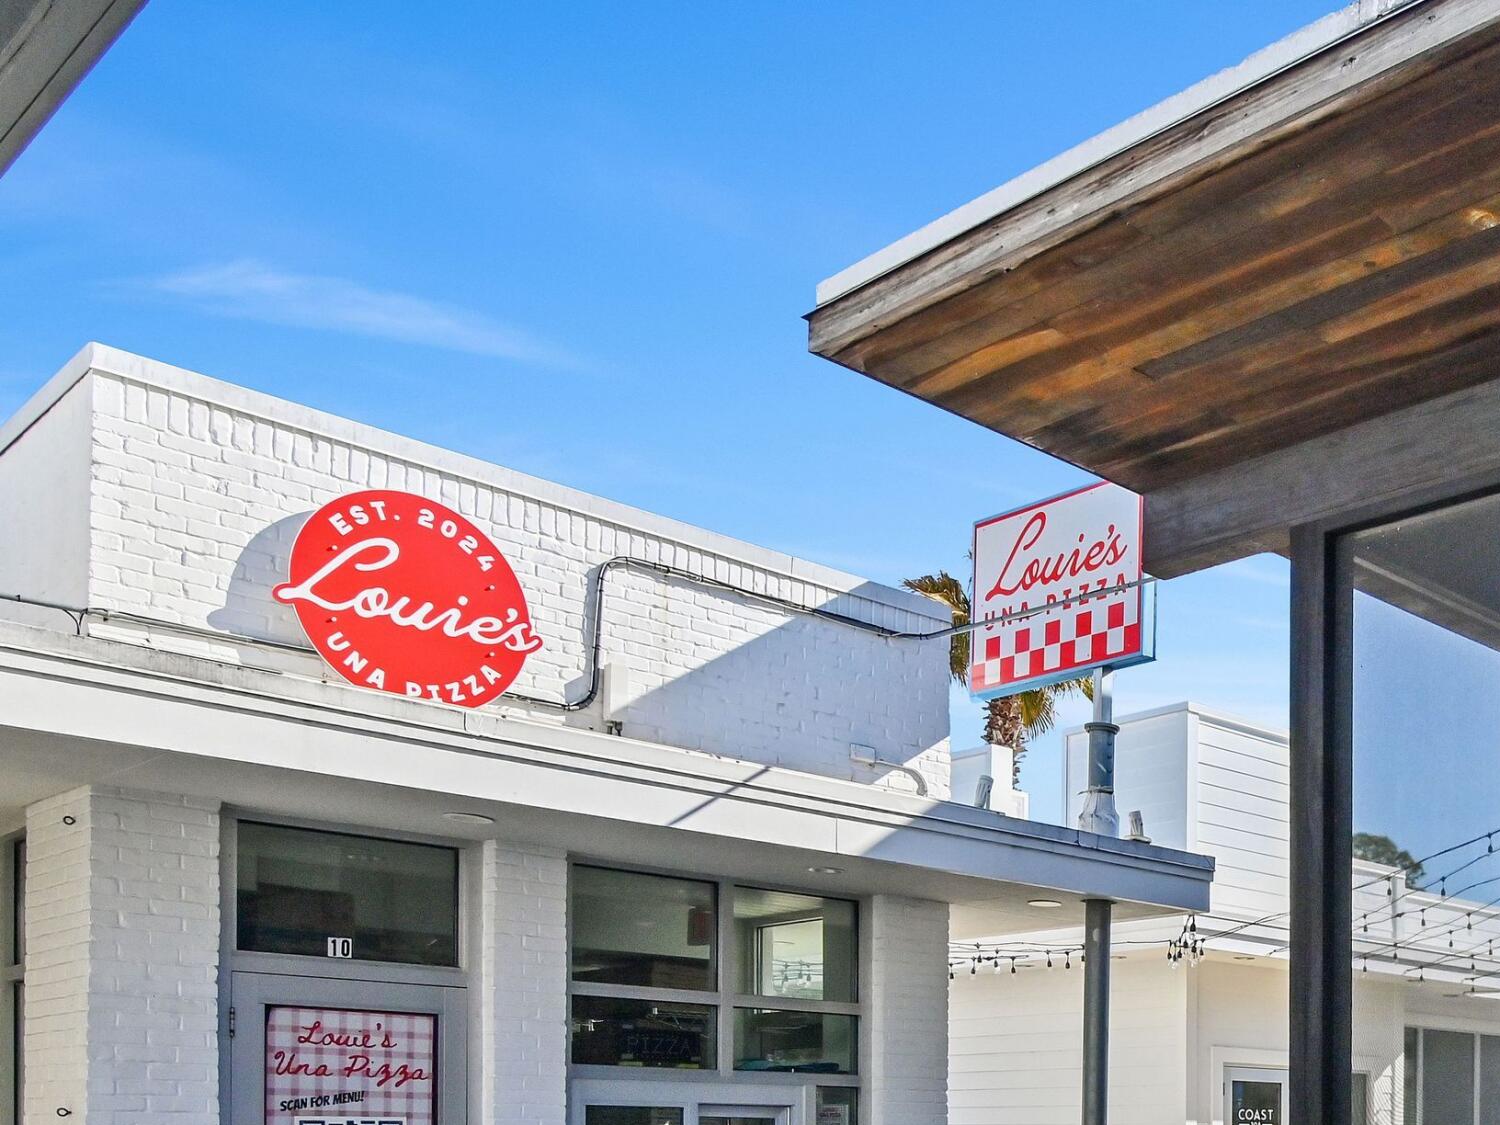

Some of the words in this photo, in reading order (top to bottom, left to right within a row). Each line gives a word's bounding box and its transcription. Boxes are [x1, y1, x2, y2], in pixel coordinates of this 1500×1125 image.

[328, 501, 400, 536] EST.
[417, 509, 495, 572] 2024
[985, 511, 1128, 602] Louie's
[277, 538, 539, 652] Louie's
[985, 602, 1030, 631] UNA
[1046, 573, 1127, 615] PIZZA
[327, 632, 385, 689] UNA
[406, 664, 501, 702] PIZZA
[331, 939, 350, 957] 10
[298, 1021, 398, 1048] Louie's
[274, 1051, 333, 1076] Una
[344, 1055, 429, 1087] Pizza
[280, 1097, 308, 1111] SCAN
[310, 1095, 330, 1107] FOR
[333, 1091, 365, 1105] MENU!
[1238, 1109, 1274, 1120] COAST
